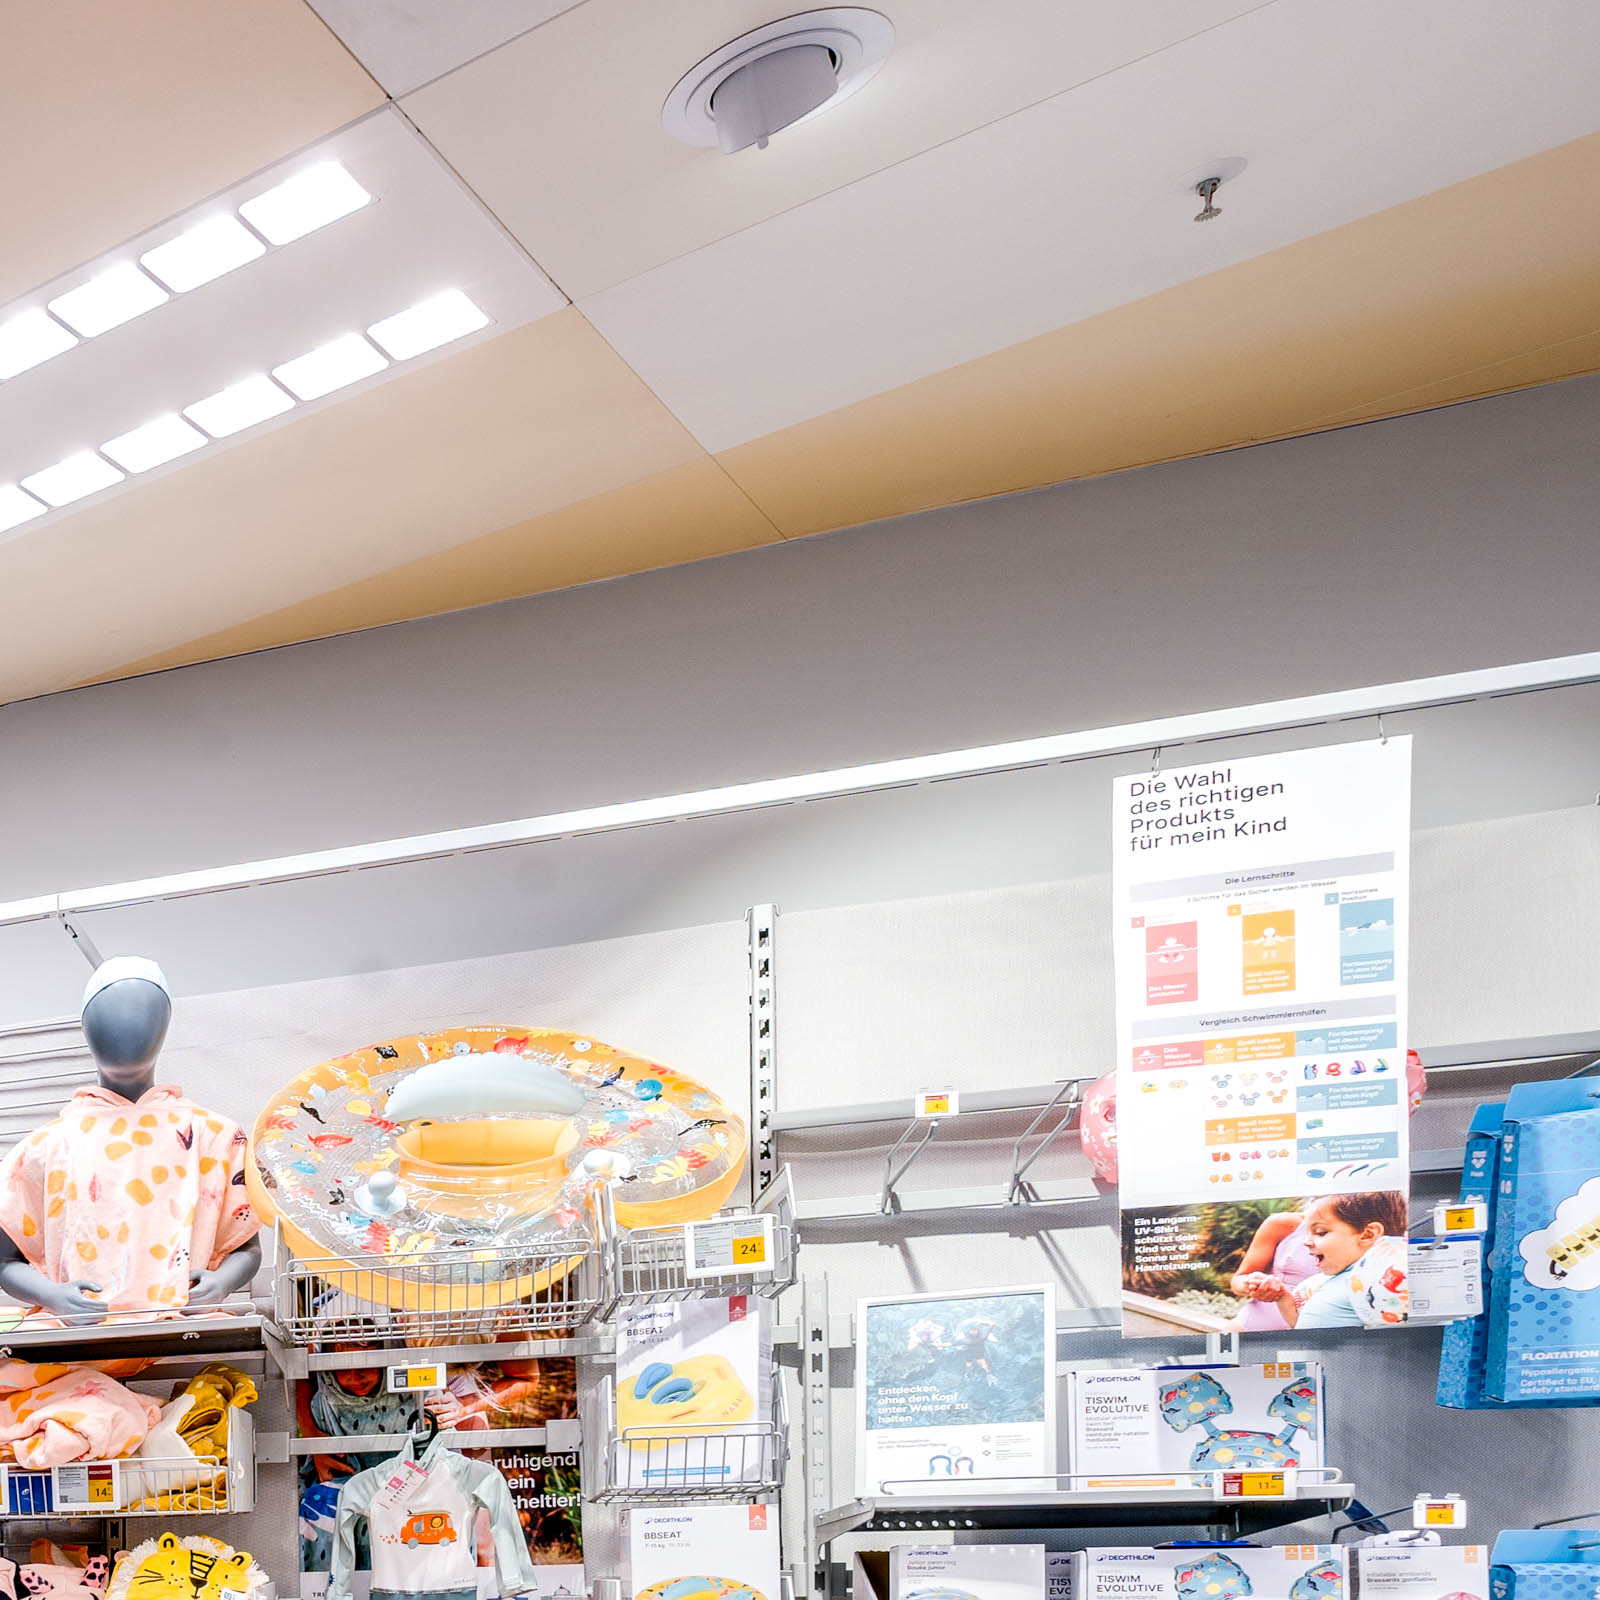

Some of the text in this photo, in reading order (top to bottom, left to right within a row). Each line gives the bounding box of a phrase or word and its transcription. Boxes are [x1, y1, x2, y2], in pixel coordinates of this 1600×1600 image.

[1130, 768, 1232, 797] Die Wahl
[1130, 782, 1285, 815] des richtigen
[1130, 808, 1235, 833] Produkts
[1130, 816, 1288, 852] für mein Kind
[1225, 870, 1296, 885] Die Lernschritte
[1200, 1008, 1327, 1028] Vergleich Schwimmlernhilfen
[1134, 1217, 1151, 1226] Ein
[1134, 1225, 1180, 1235] UV-Shirt
[1175, 1234, 1198, 1242] dein
[740, 1243, 758, 1255] 24
[1134, 1245, 1159, 1254] Kind
[1178, 1243, 1197, 1251] der
[1135, 1254, 1168, 1263] Sonne
[1135, 1261, 1211, 1273] Hautreizungen
[626, 1326, 664, 1337] BBSEAT
[1521, 1349, 1600, 1361] FLOATATION
[1096, 1375, 1142, 1384] DECATHLON
[877, 1391, 959, 1405] ohne den Kopf
[1085, 1395, 1128, 1405] TISWIM
[910, 1403, 951, 1413] Wasser
[1085, 1404, 1150, 1414] EVOLUTIVE
[877, 1414, 913, 1425] halten
[507, 1474, 536, 1489] ein
[94, 1487, 107, 1497] 14
[512, 1492, 582, 1509] heltier!
[653, 1516, 693, 1525] DECATHLON
[643, 1530, 682, 1541] BBSEAT
[1108, 1554, 1156, 1562] DECATHLON
[1096, 1575, 1142, 1584] TISWIM
[1096, 1584, 1164, 1593] EVOLUTIVE
